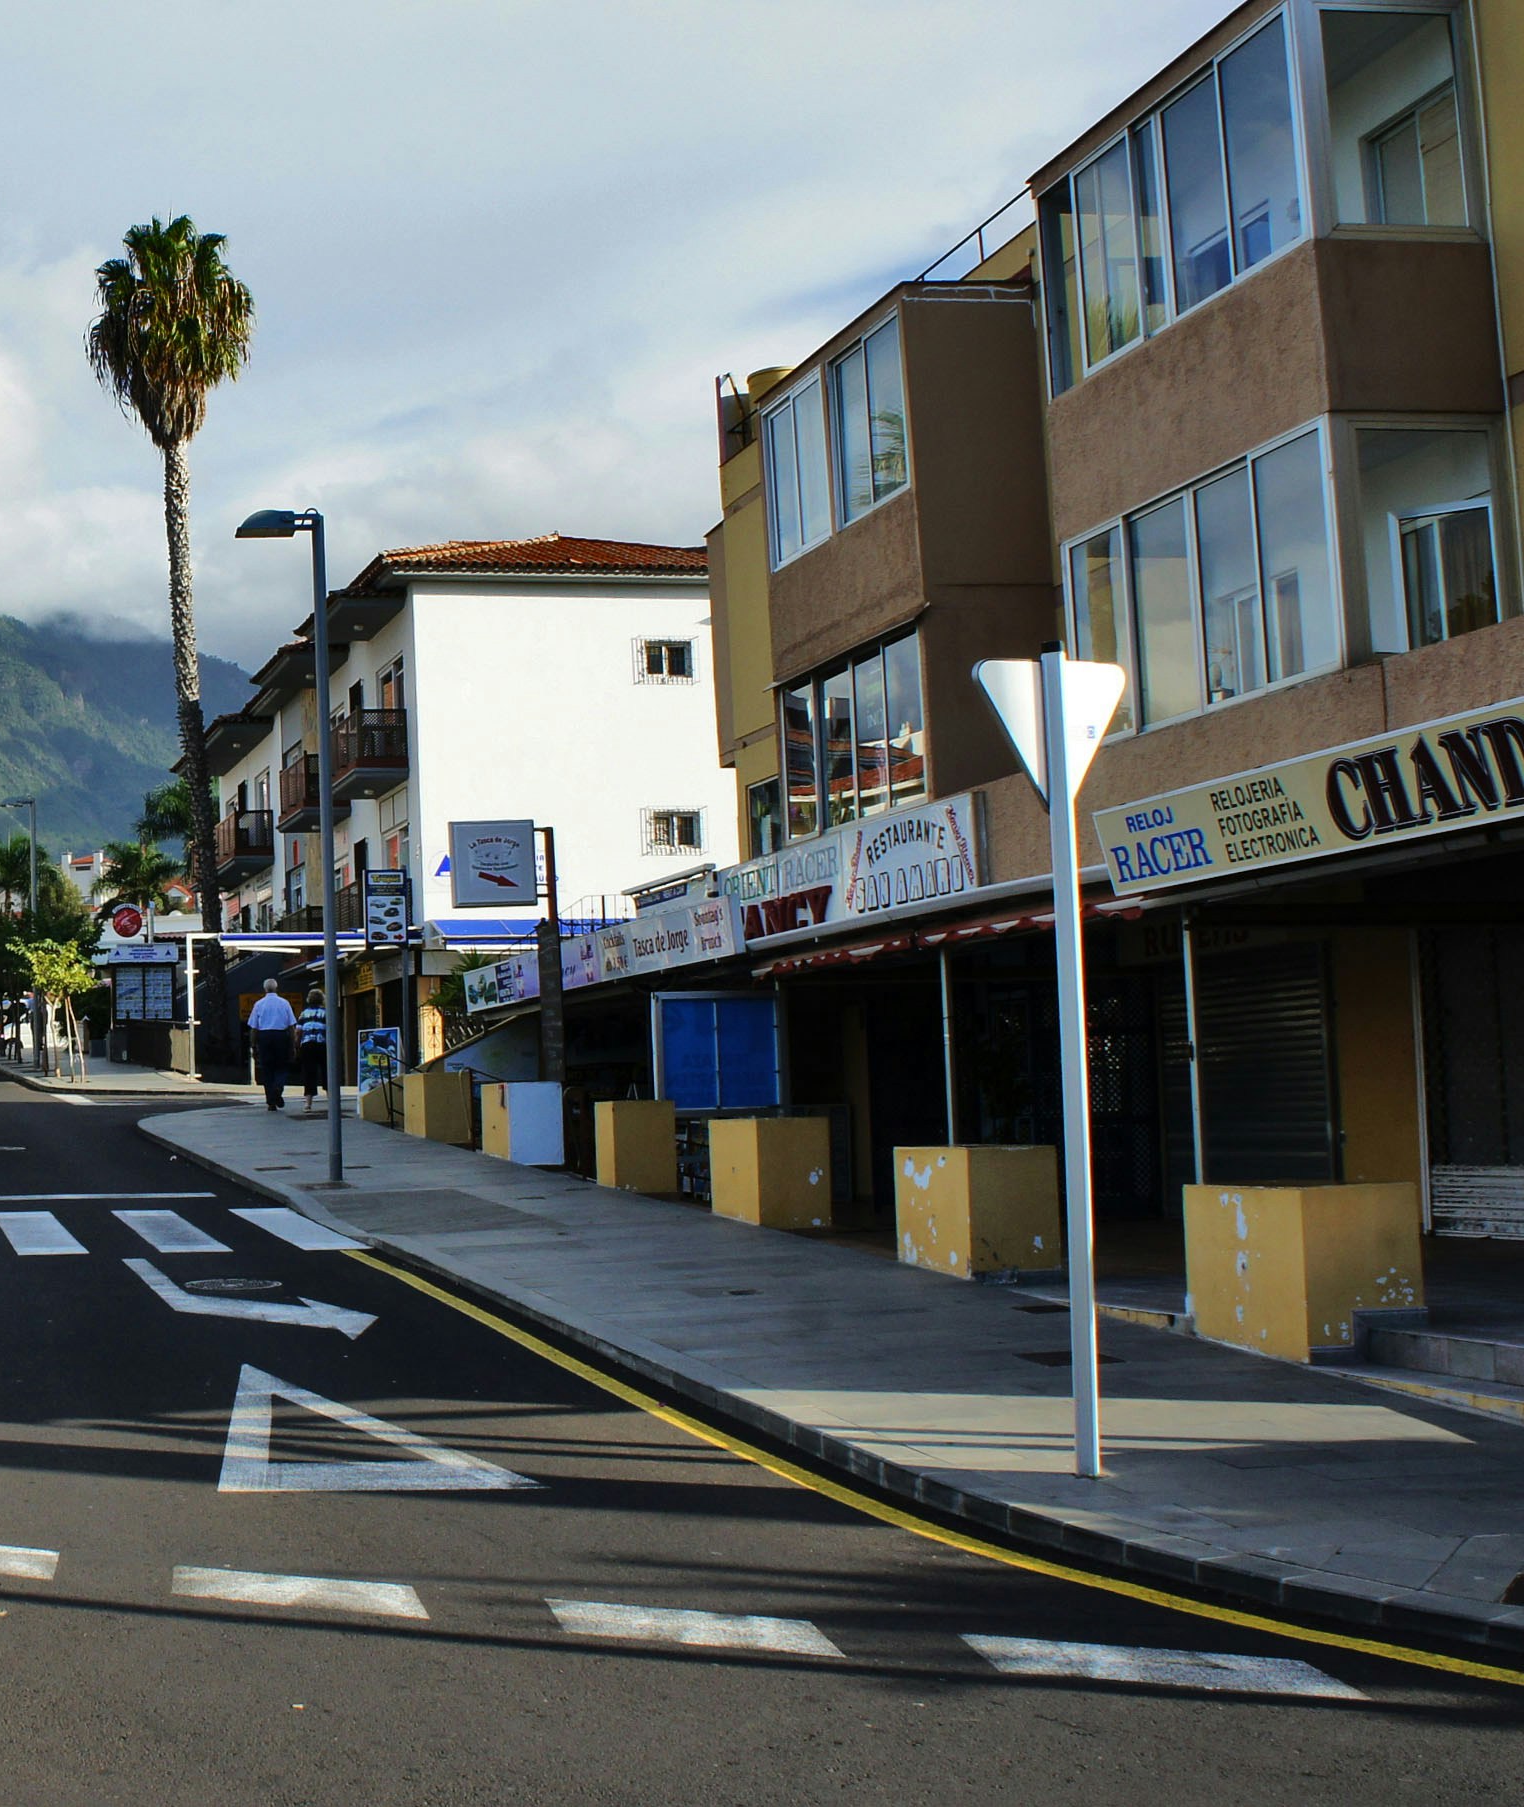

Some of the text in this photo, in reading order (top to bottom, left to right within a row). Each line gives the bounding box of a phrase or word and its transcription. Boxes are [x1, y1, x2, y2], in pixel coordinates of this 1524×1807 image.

[1210, 777, 1285, 812] RELOJERIA
[1125, 806, 1174, 833] RELOJ
[1217, 797, 1304, 838] FOTOGRAFÍA
[866, 819, 945, 868] RESTAURANTE
[1110, 828, 1213, 883] RACER
[1225, 825, 1321, 863] ELECTRONICA
[724, 863, 776, 901] ORIENT
[783, 846, 838, 890] RACER
[740, 885, 833, 940] ANCY
[632, 929, 690, 958] Tasca de Jorge
